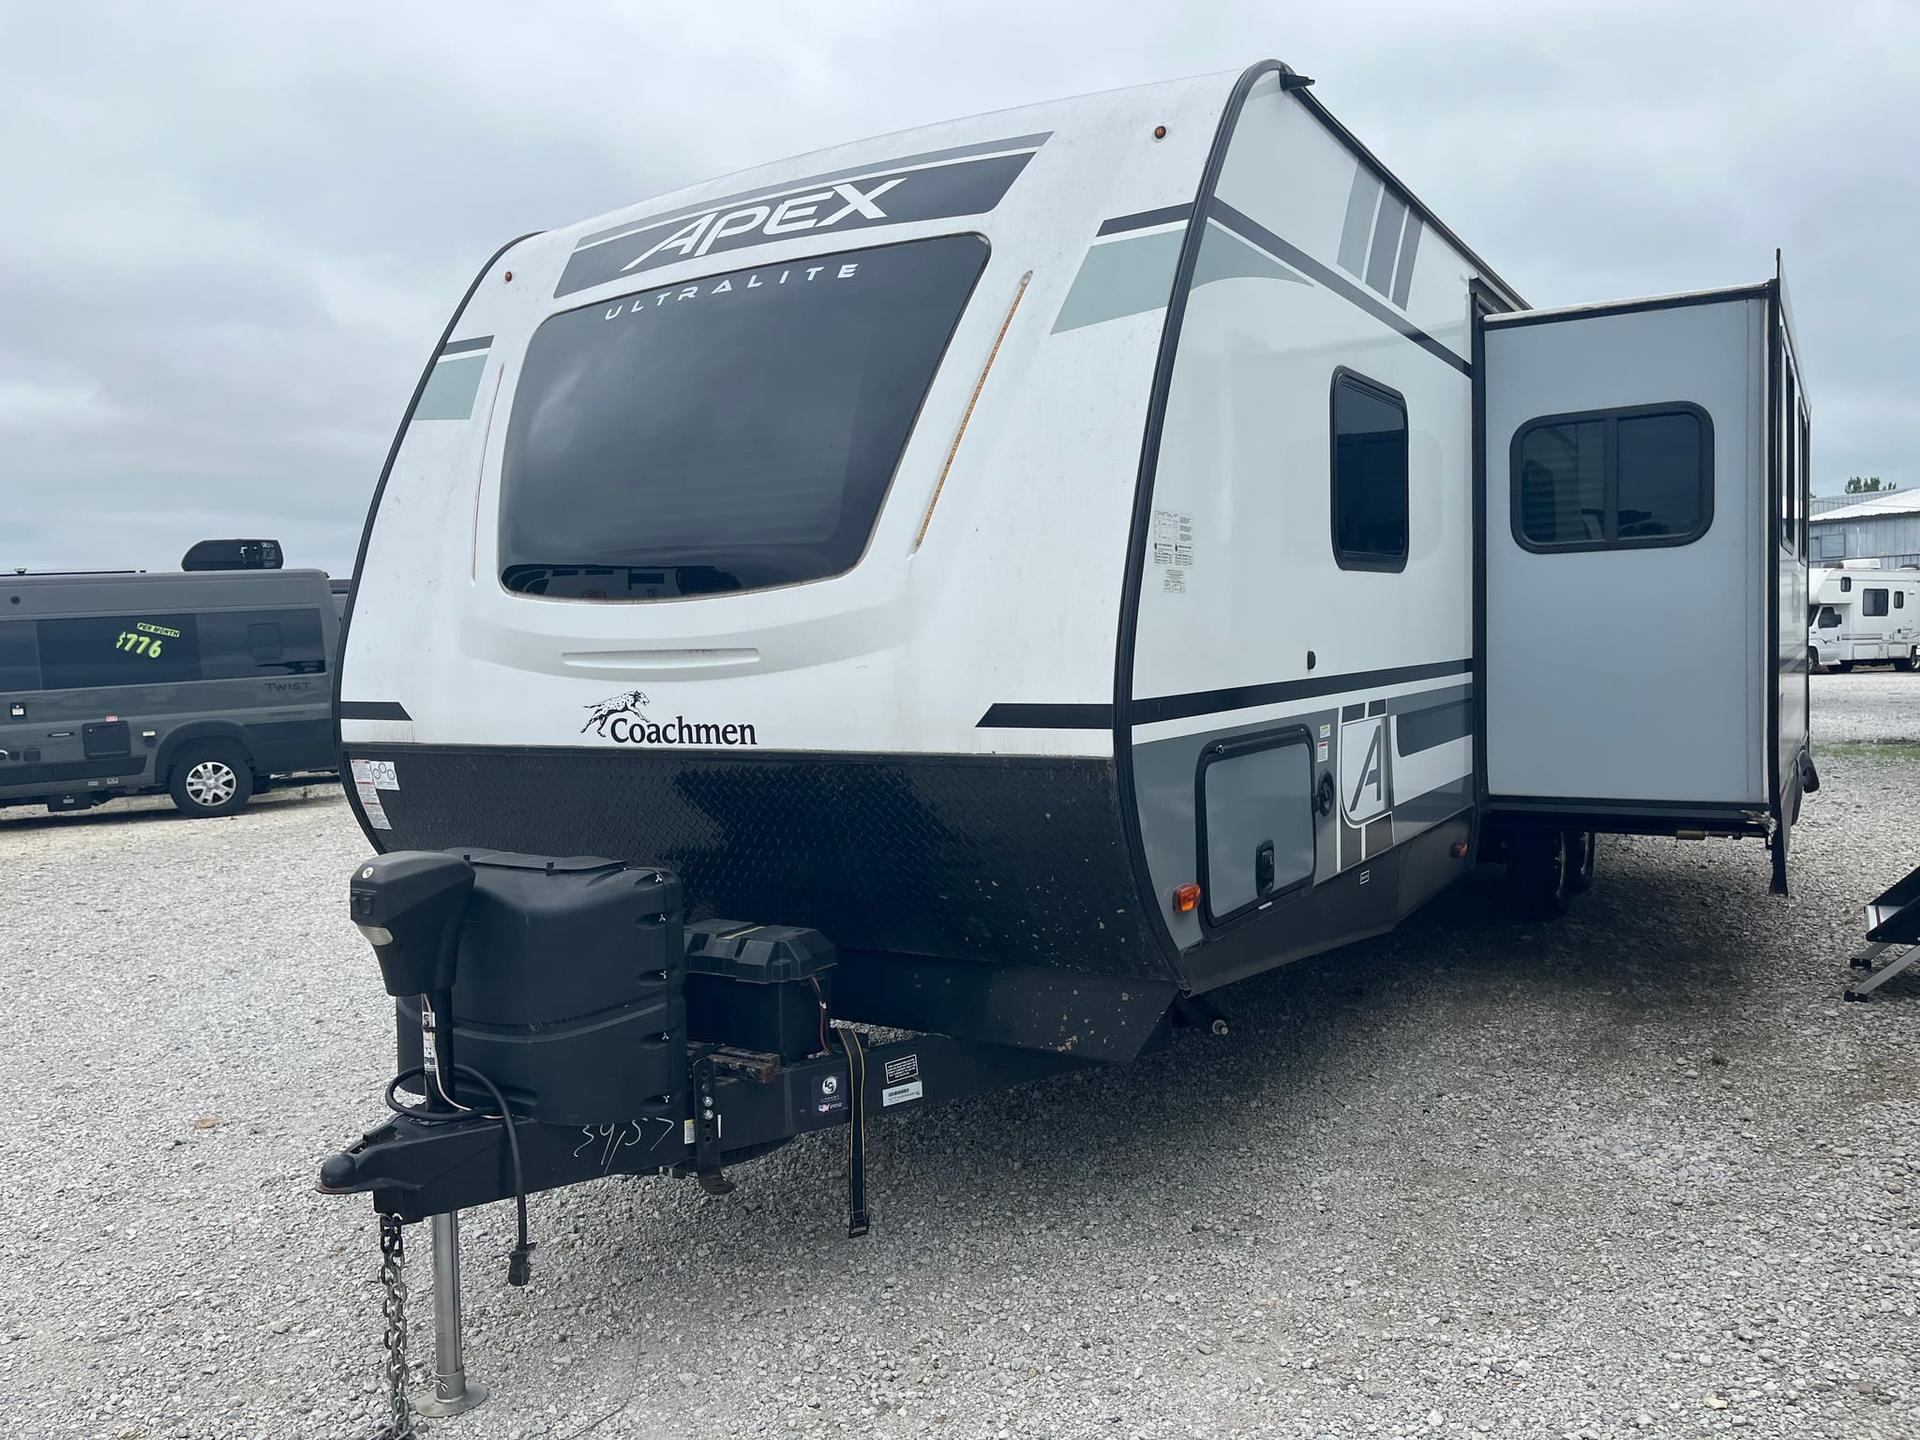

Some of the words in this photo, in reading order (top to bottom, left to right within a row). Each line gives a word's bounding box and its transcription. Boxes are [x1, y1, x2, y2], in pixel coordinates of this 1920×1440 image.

[620, 177, 907, 272] APEX
[604, 263, 860, 321] ULTRALITE
[138, 623, 153, 631] PER
[153, 627, 179, 637] MONTH
[115, 631, 163, 659] $776
[263, 681, 313, 692] TWIST
[610, 715, 758, 746] Coachmen
